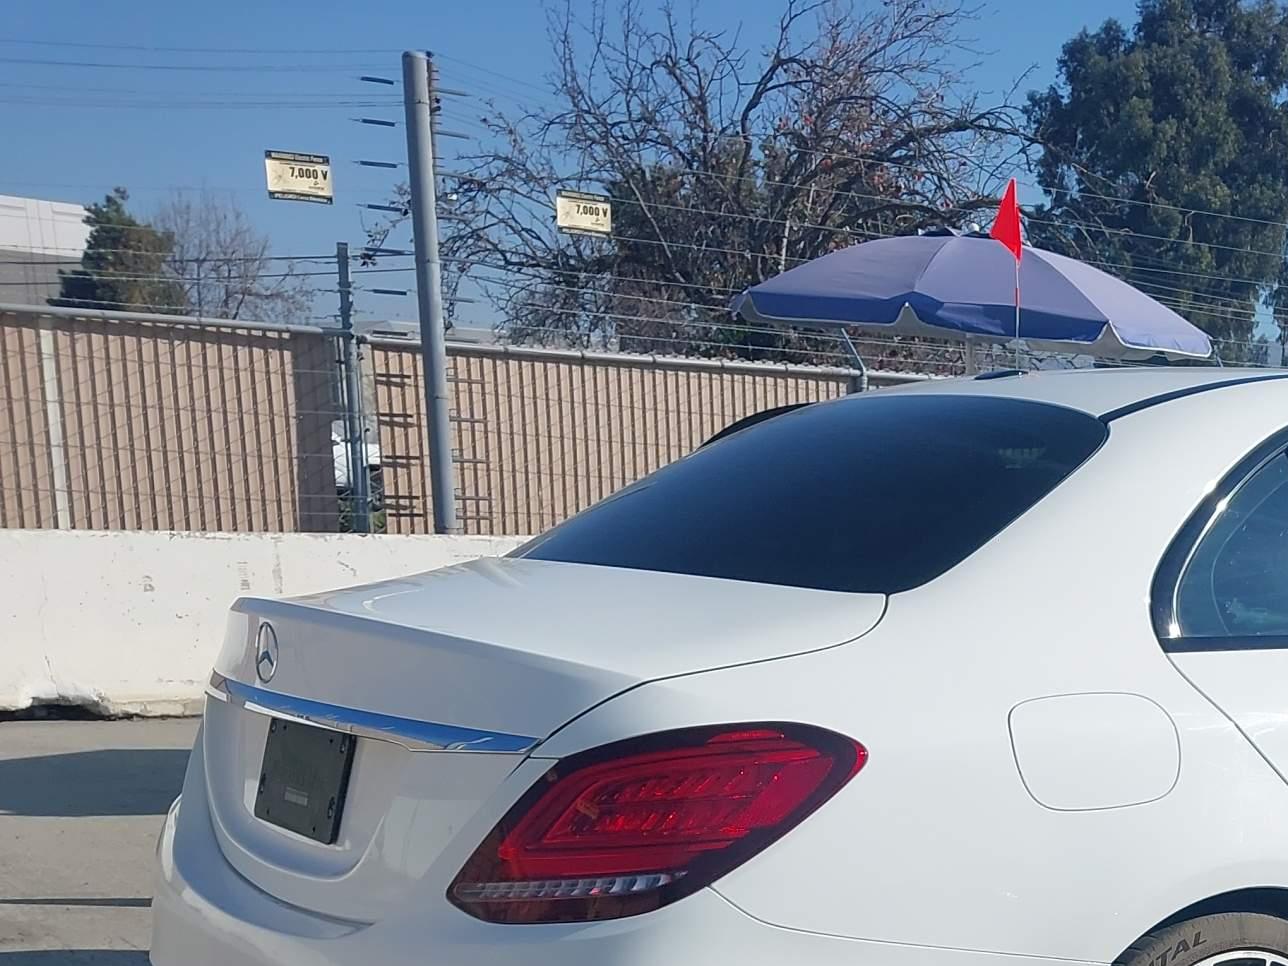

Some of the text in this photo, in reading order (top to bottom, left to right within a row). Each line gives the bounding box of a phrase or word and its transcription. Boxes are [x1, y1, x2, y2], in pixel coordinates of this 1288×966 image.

[289, 166, 328, 181] 7,000 V
[576, 203, 608, 218] 7,000 V
